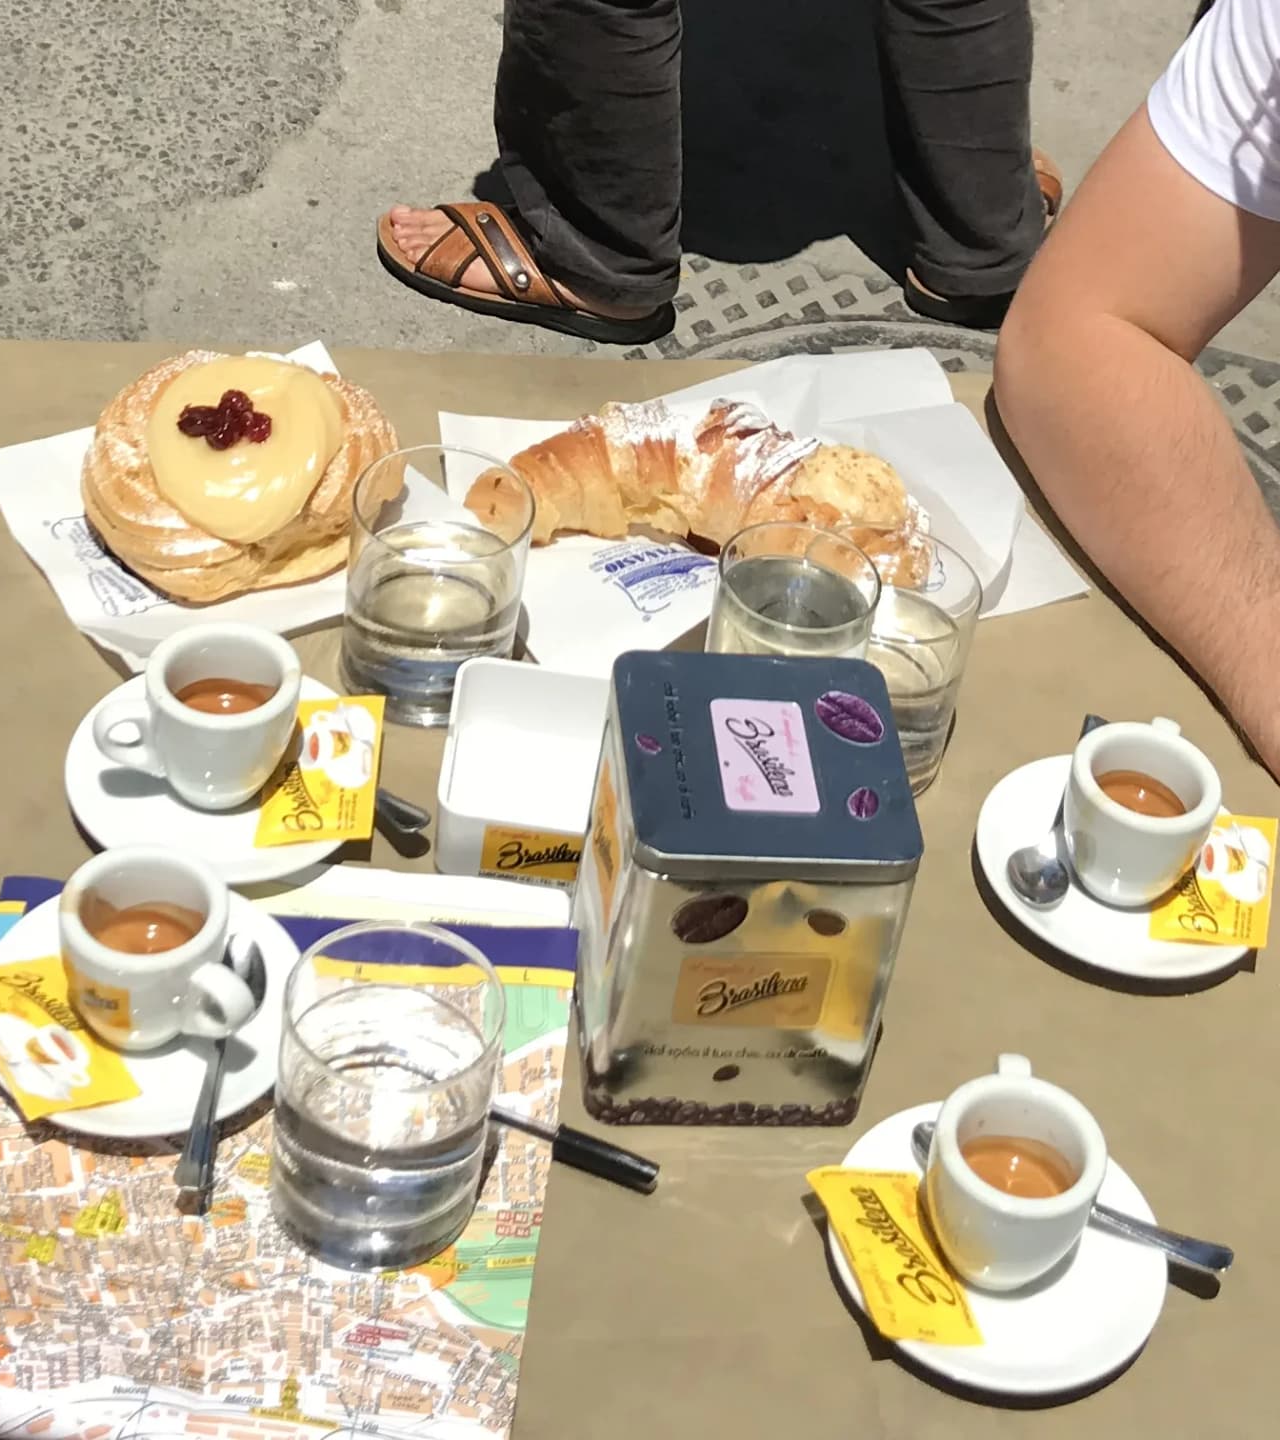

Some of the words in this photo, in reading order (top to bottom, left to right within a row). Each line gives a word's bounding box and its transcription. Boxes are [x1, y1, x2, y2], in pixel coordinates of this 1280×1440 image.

[696, 969, 809, 1017] Brasilena
[850, 1184, 956, 1307] Brasilena
[223, 1393, 264, 1406] Marina
